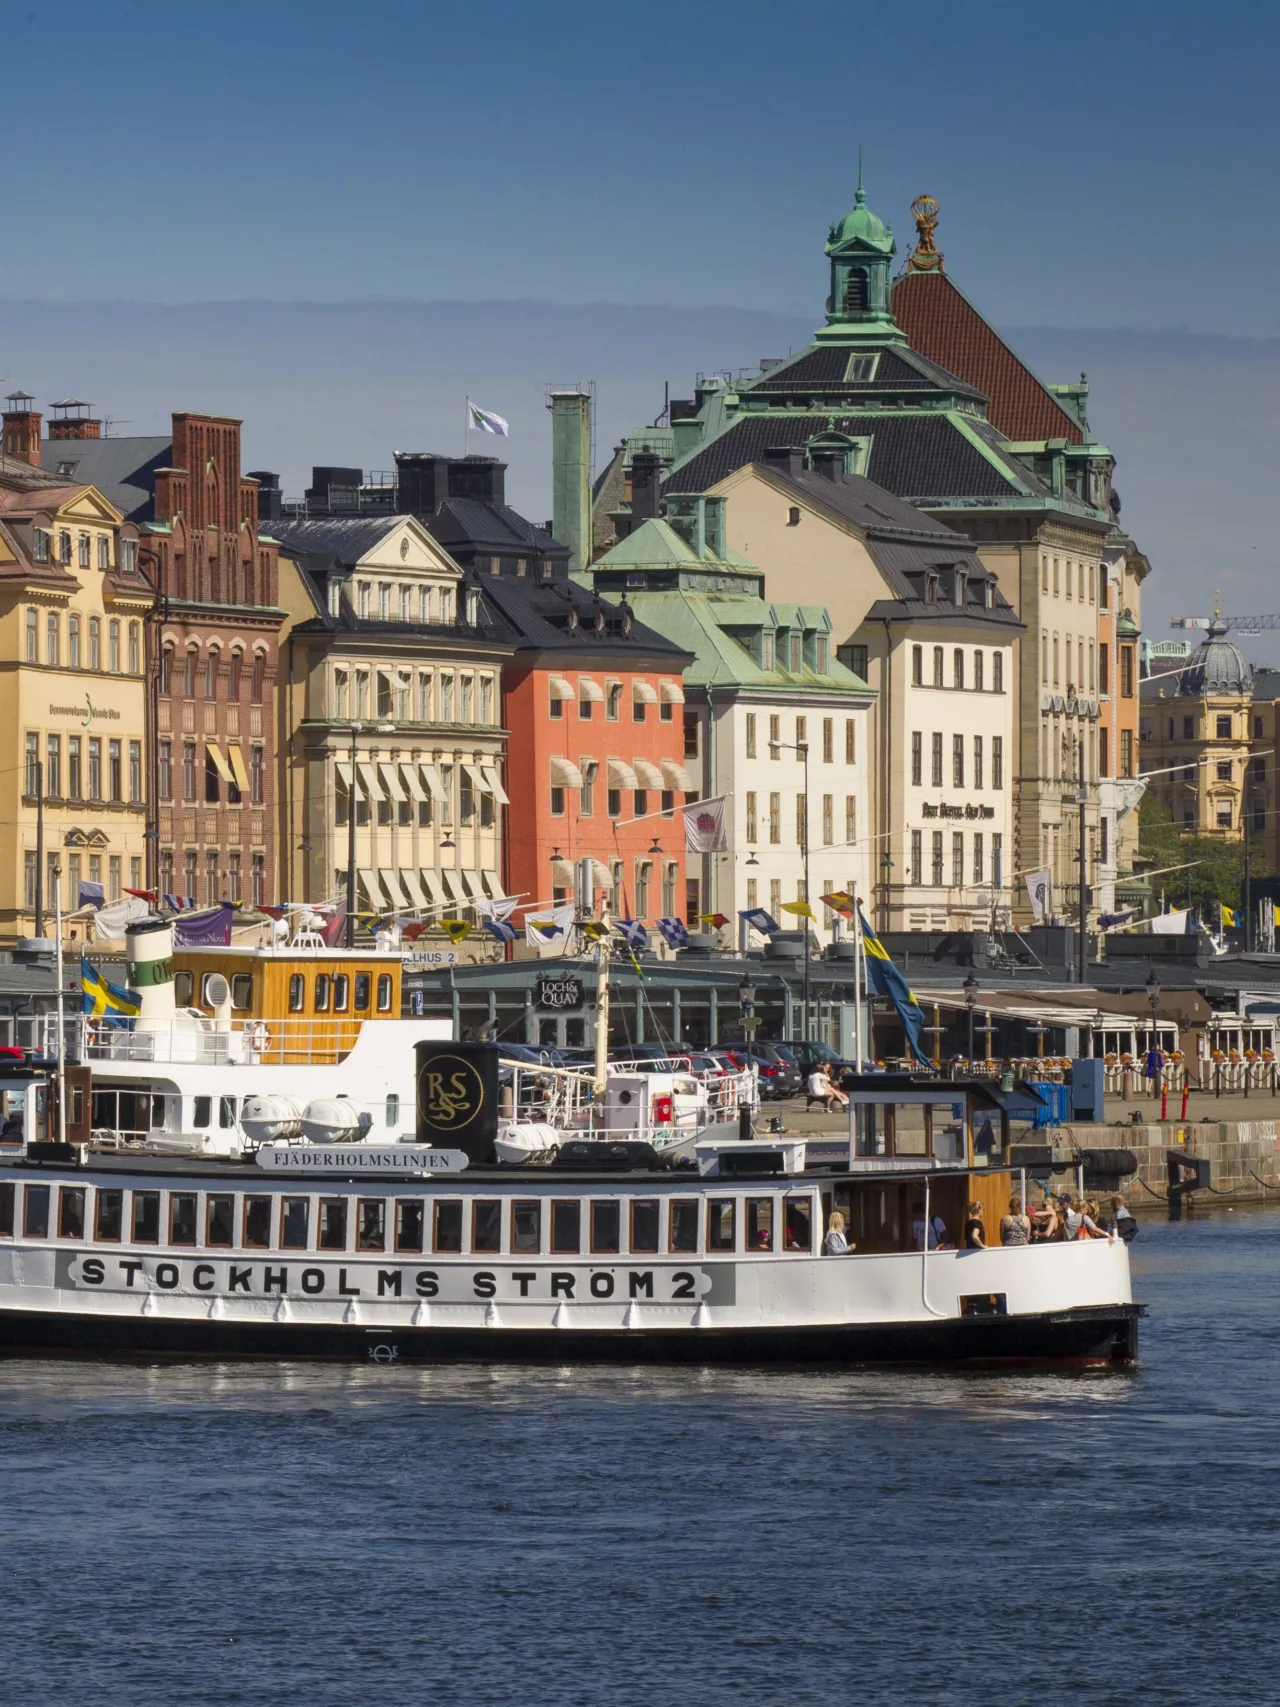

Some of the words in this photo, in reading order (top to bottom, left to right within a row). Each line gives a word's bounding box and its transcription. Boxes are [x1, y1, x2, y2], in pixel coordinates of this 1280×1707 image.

[448, 953, 455, 962] 2
[542, 981, 578, 993] LOCH&
[541, 992, 579, 1006] QUAY
[274, 1151, 450, 1168] FJÄDERHOLMSLINJEN
[82, 1258, 439, 1297] STOCKHOLMS
[473, 1268, 654, 1299] STRÖM
[671, 1271, 696, 1299] 2
